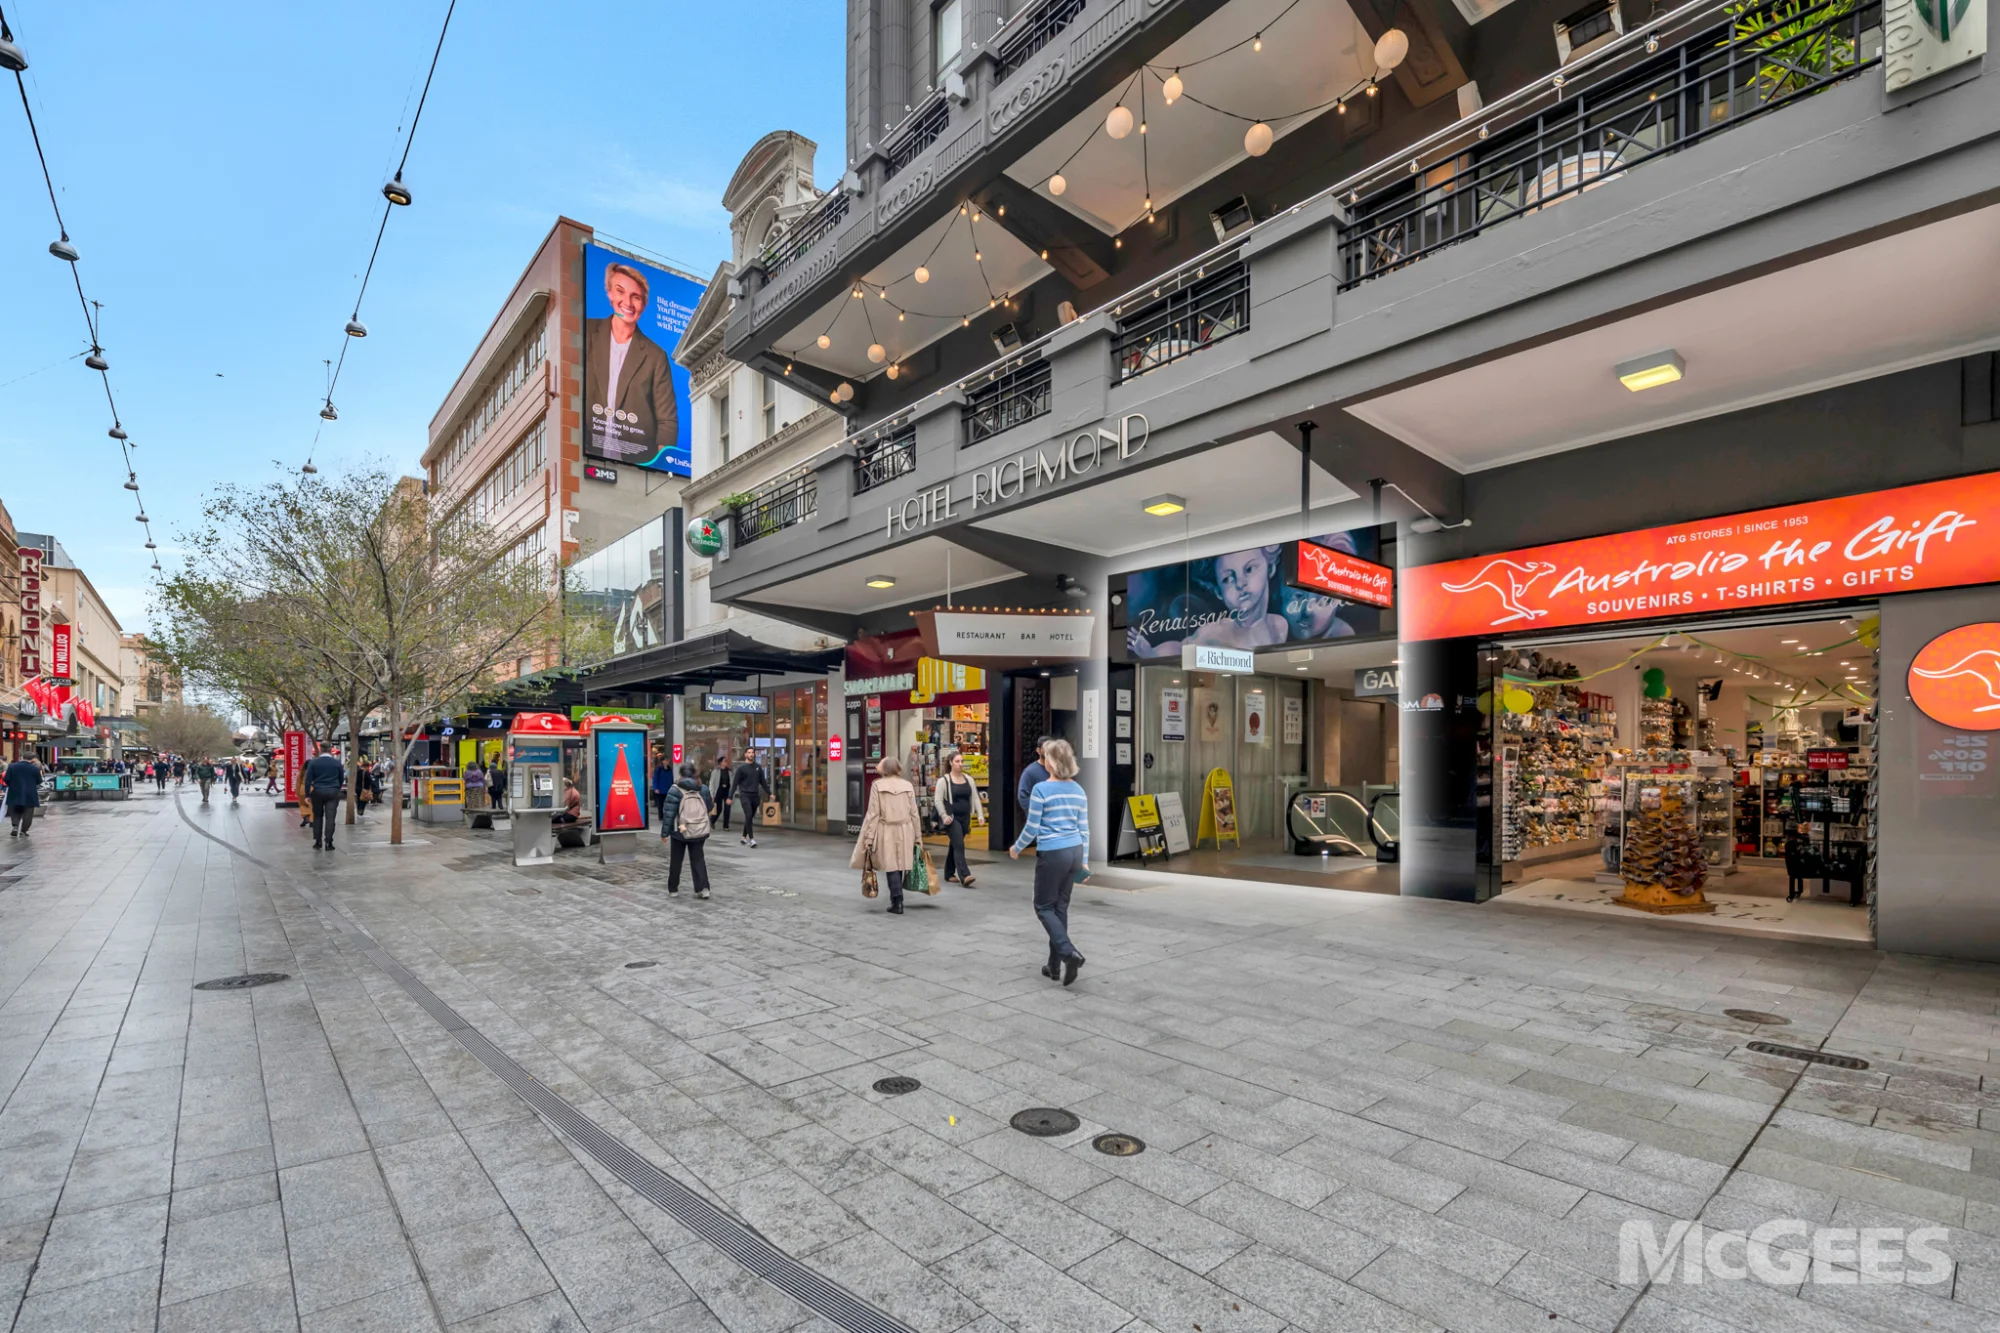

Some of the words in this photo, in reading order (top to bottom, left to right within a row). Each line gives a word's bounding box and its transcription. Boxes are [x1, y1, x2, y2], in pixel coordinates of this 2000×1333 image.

[887, 484, 957, 538] HOTEL
[973, 413, 1149, 510] RICHMOND
[1666, 535, 1687, 545] ATG
[1689, 528, 1733, 542] STORES
[1743, 520, 1779, 533] SINCE
[1783, 516, 1809, 528] 1953
[1548, 549, 1749, 599] Australia
[1759, 538, 1834, 571] the
[1843, 510, 1978, 563] Gift
[1327, 562, 1361, 581] Australia
[1587, 591, 1694, 614] SOUVENIRS
[1716, 576, 1816, 601] T-SHIRTS
[1843, 565, 1915, 586] GIFTS
[21, 555, 40, 670] REGENT
[957, 632, 1006, 640] RESTAURANT
[1131, 606, 1249, 645] Renaissance
[56, 634, 68, 660] COTTON
[56, 661, 68, 673] ON
[1207, 651, 1252, 668] Richmond
[844, 673, 915, 696] SMOKEMART
[441, 727, 454, 735] JD
[488, 719, 502, 728] JD
